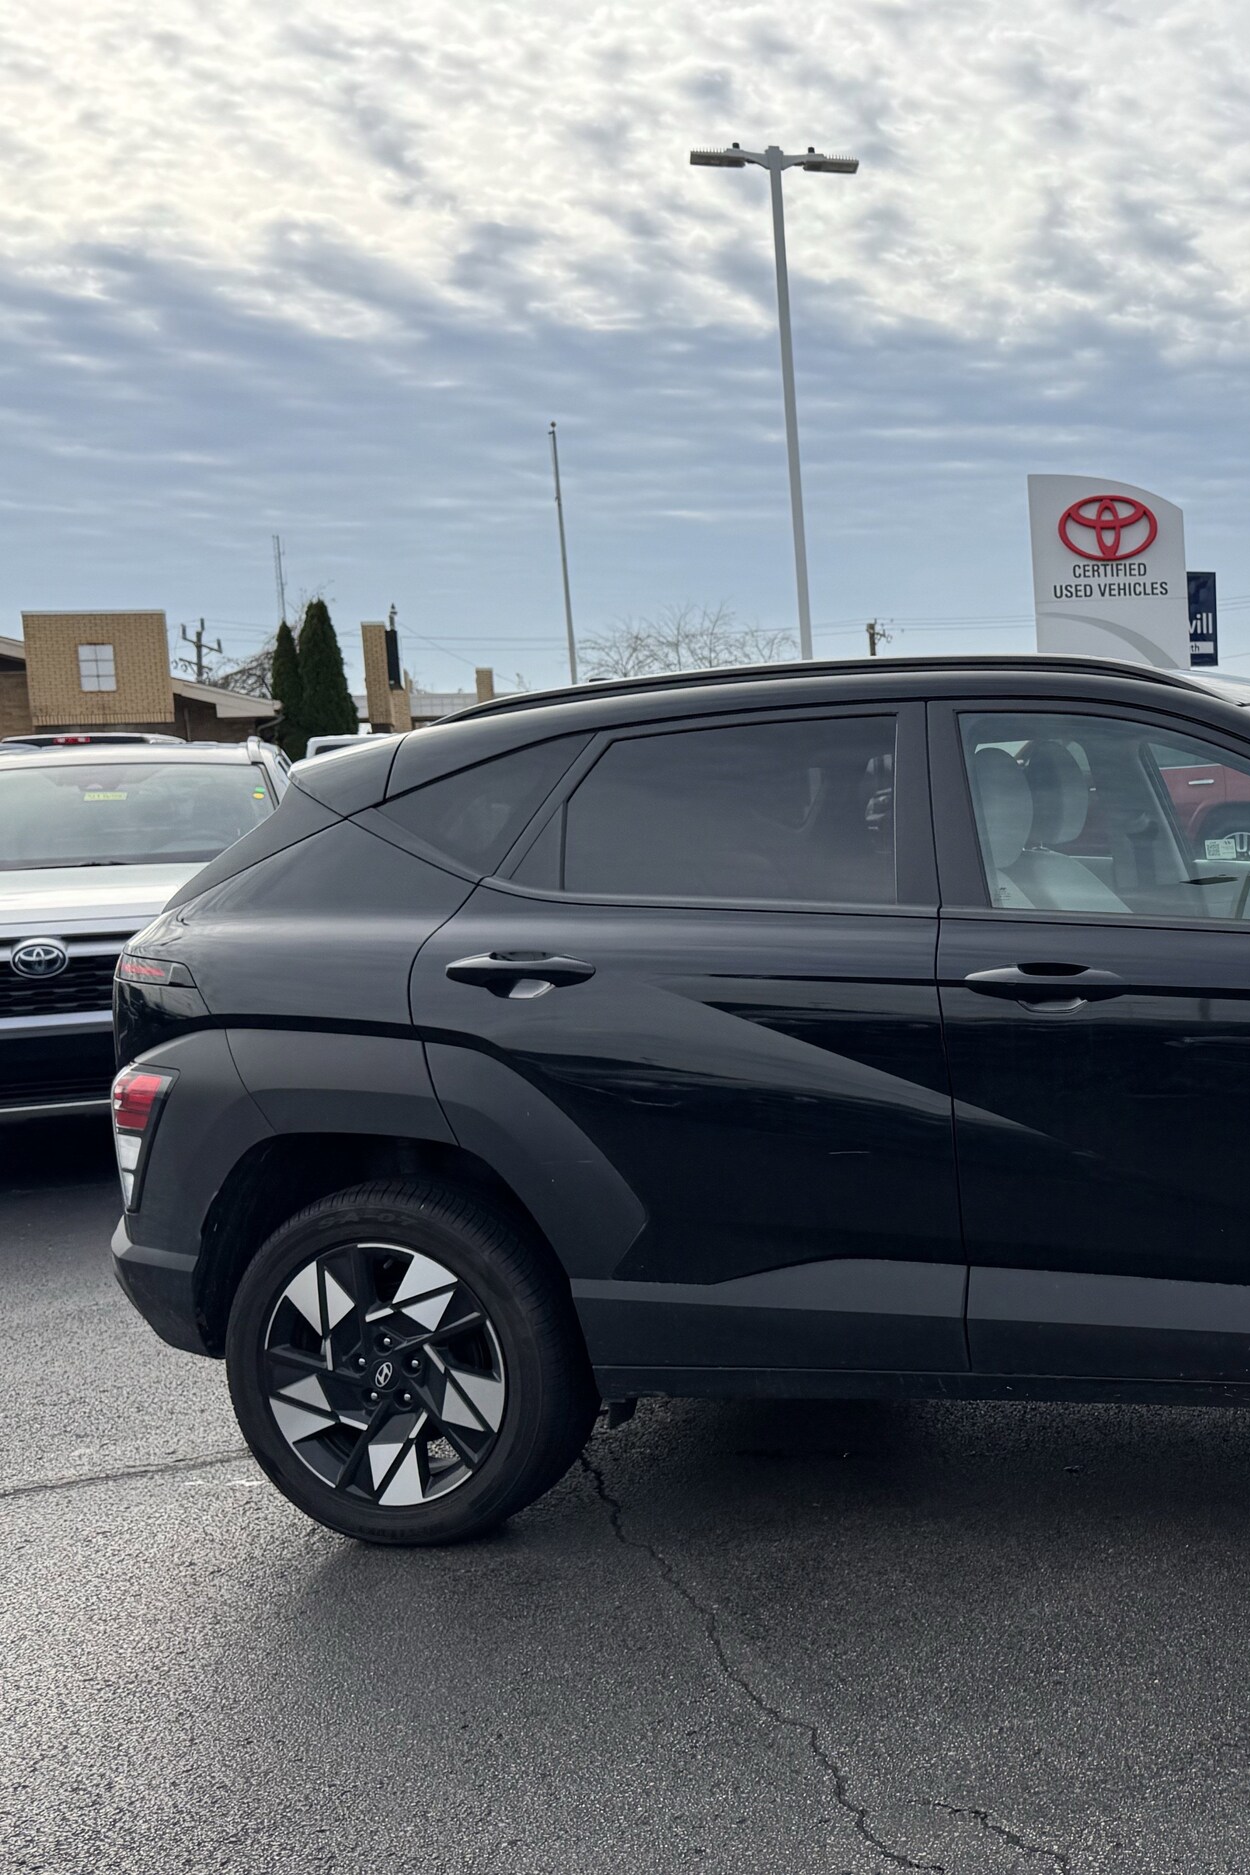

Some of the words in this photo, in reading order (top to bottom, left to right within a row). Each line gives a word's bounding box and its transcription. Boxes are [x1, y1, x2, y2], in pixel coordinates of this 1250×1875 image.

[1072, 562, 1147, 579] CERTIFIED
[1053, 583, 1093, 599] USED
[1098, 581, 1169, 597] VEHICLES
